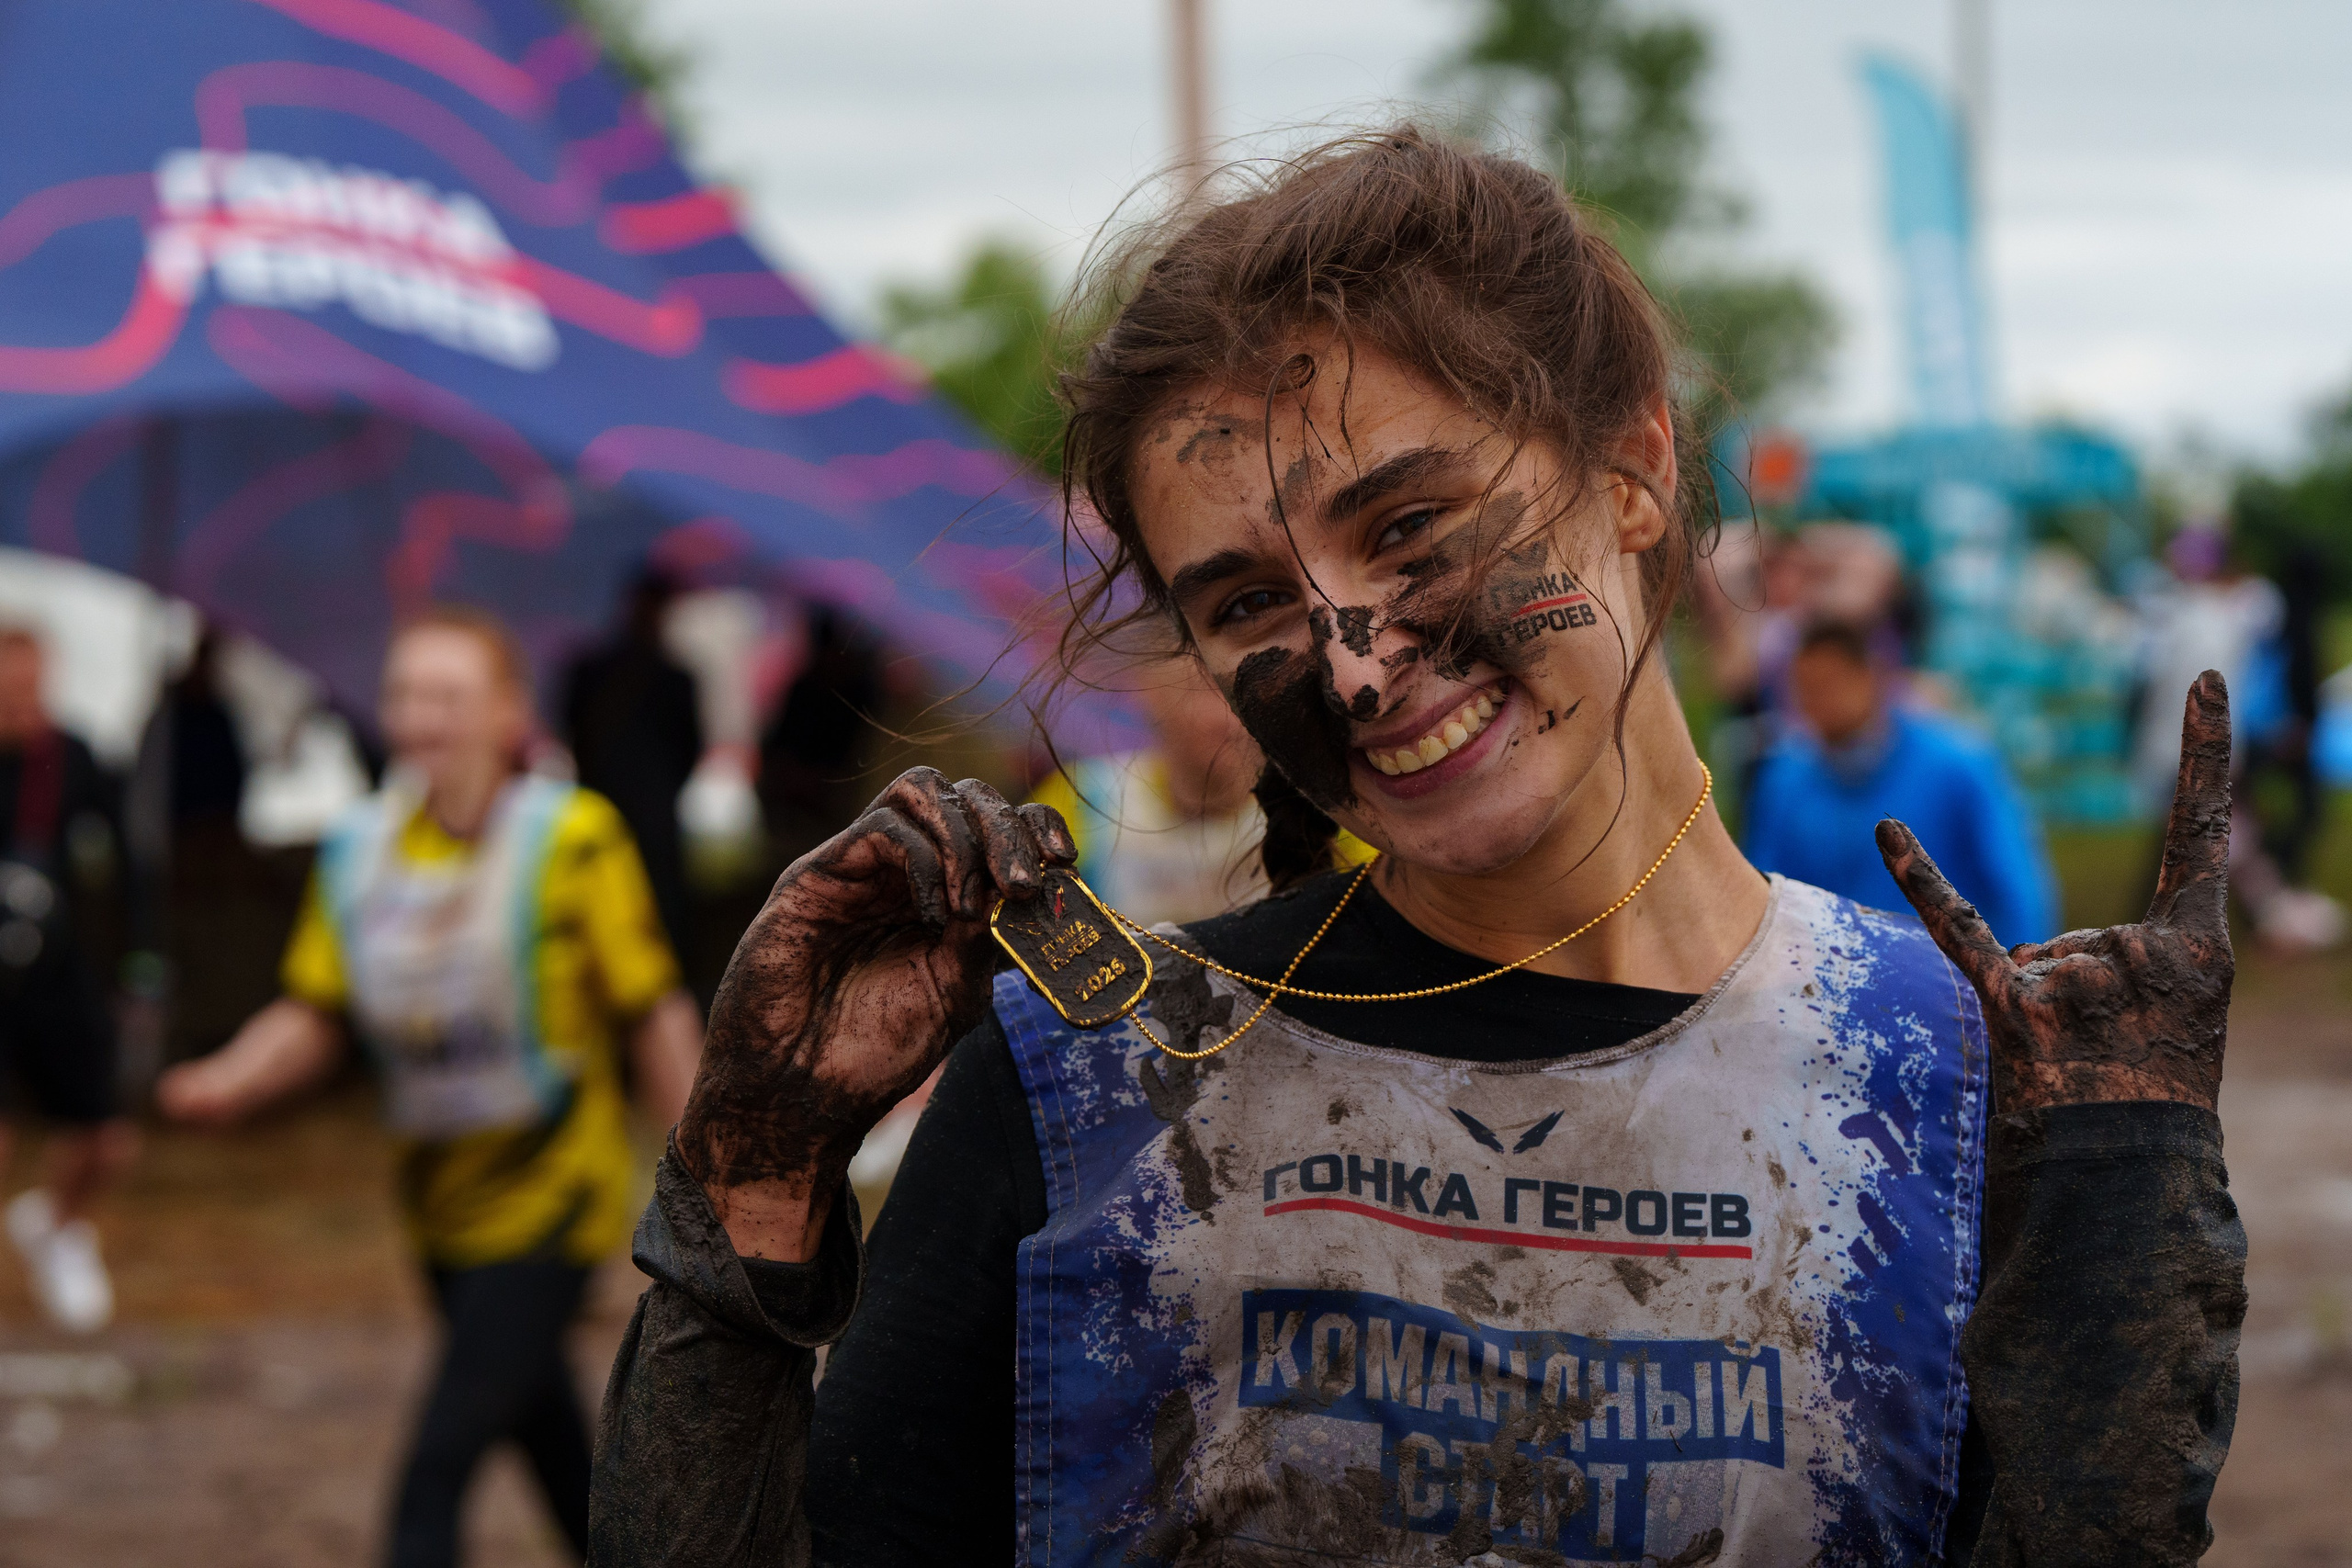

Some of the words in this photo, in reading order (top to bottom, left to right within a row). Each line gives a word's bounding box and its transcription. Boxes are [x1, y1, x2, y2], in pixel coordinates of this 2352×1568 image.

[1498, 604, 1597, 647] ГЕРОЕВ
[1074, 957, 1126, 1002] 2025
[1263, 1154, 1479, 1221] ГОНКА
[1503, 1177, 1752, 1238] ГЕРОЕВ
[1252, 1310, 1771, 1453] КОМАНДНЫЙ
